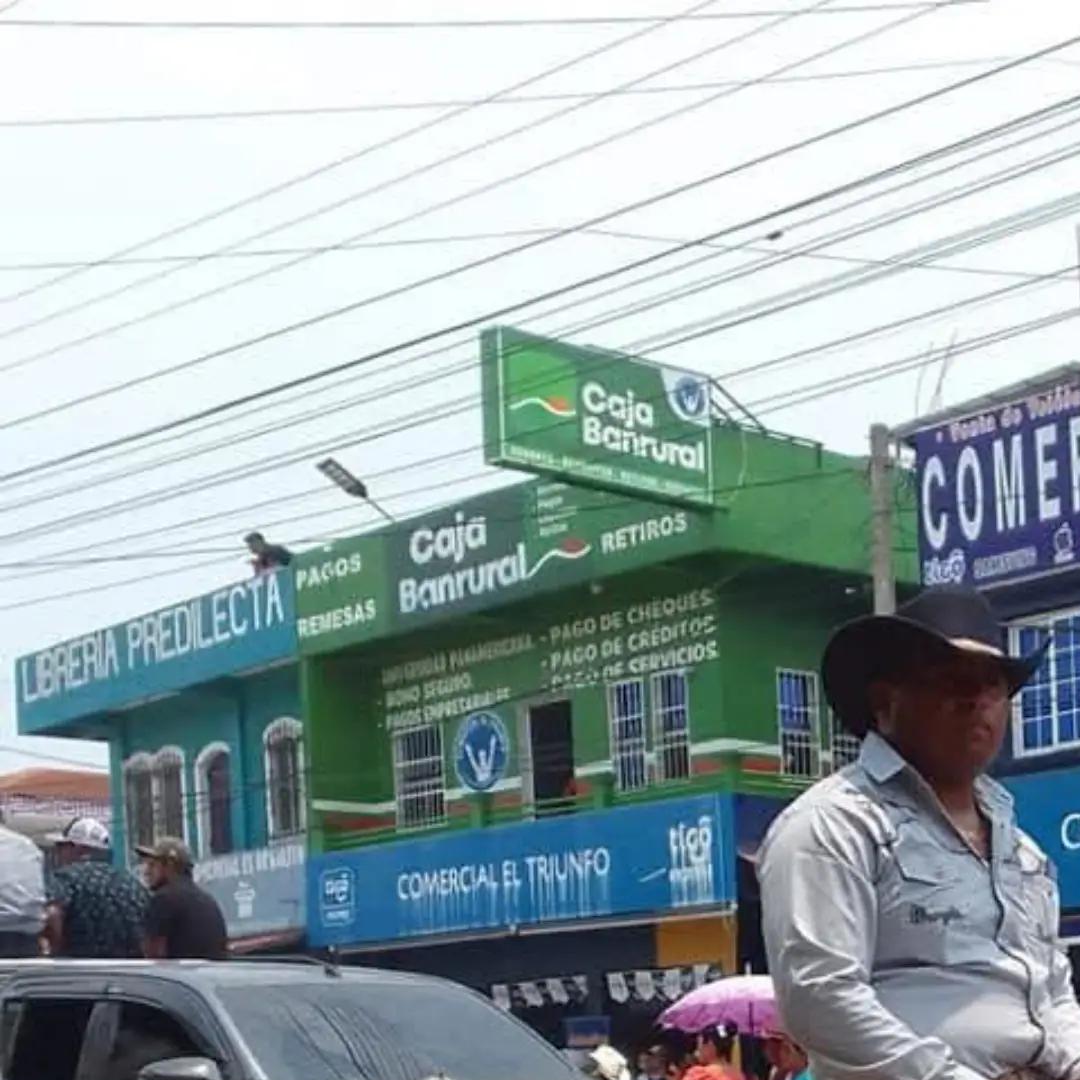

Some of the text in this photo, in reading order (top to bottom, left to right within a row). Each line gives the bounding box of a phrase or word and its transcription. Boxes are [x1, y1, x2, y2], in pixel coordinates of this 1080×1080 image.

[581, 381, 654, 428] Caja
[582, 416, 705, 472] Banrural
[409, 511, 487, 564] Caja
[601, 512, 689, 555] RETIROS
[296, 553, 361, 590] PAGOS
[399, 543, 528, 613] Banrural
[128, 572, 285, 669] PREDILECTA
[297, 598, 376, 639] REMESAS
[600, 611, 624, 632] DE
[627, 588, 715, 625] CHEQUES
[601, 637, 624, 659] DE
[629, 640, 719, 674] SERVICIOS
[398, 848, 611, 900] COMERCIAL EL TRIUNFO
